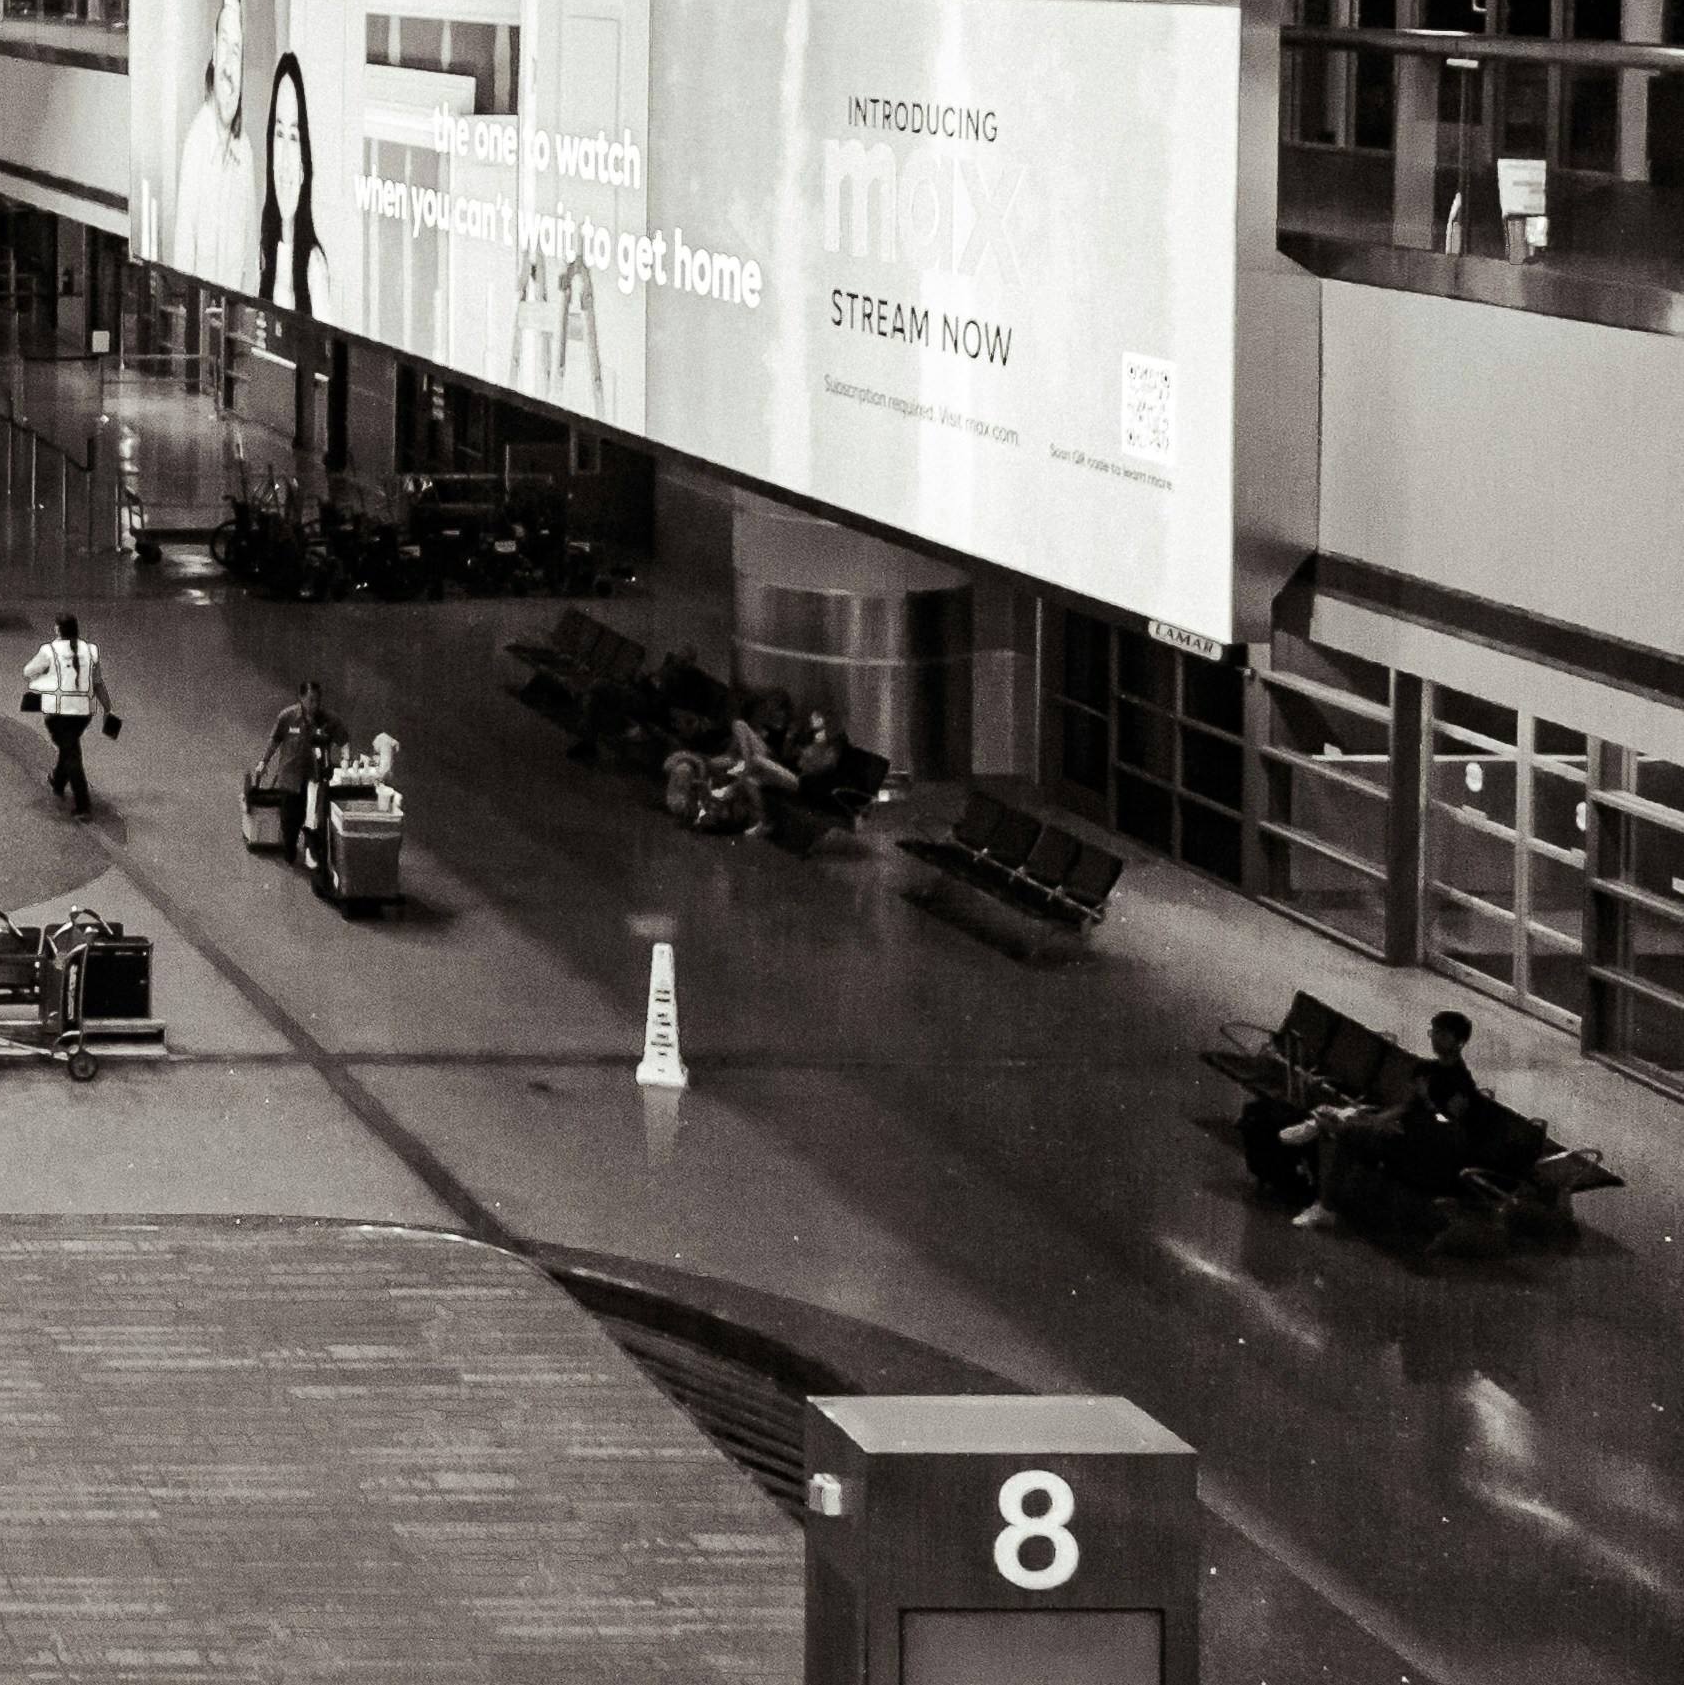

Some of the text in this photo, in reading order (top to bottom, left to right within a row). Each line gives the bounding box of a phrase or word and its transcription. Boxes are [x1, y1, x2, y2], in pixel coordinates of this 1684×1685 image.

[432, 102, 642, 190] the one to watch
[847, 95, 998, 143] INTRODUCING
[352, 170, 763, 309] when you can't wait to get home
[821, 136, 1028, 288] max
[830, 288, 1013, 368] STREAM NOW
[1155, 623, 1215, 657] LAMAR
[992, 1468, 1081, 1591] 8
